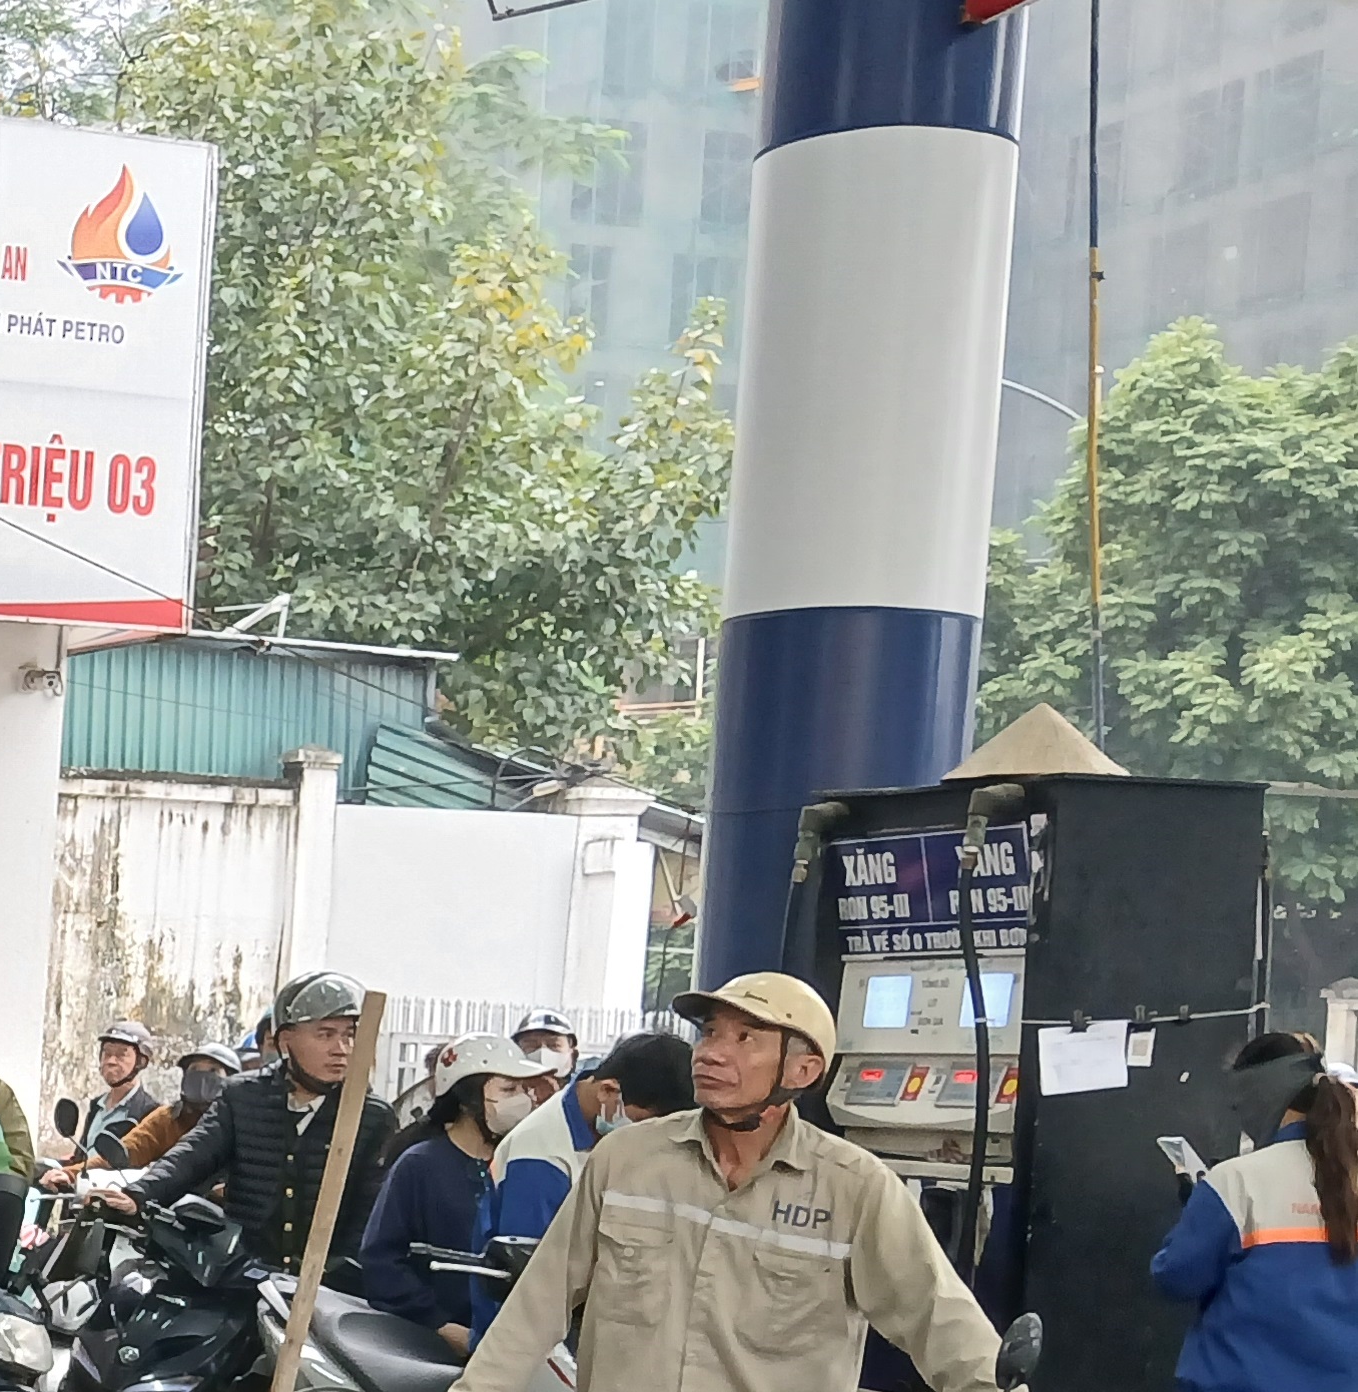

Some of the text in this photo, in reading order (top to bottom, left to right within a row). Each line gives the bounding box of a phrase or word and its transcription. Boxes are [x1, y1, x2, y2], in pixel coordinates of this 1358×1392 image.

[1, 245, 28, 281] AN
[95, 262, 144, 284] NTC
[7, 312, 56, 337] PHÁT
[63, 320, 125, 344] PETRO
[107, 453, 157, 517] 03
[842, 848, 896, 887] XĂNG
[838, 896, 869, 921] RON
[771, 1200, 831, 1231] HDP
